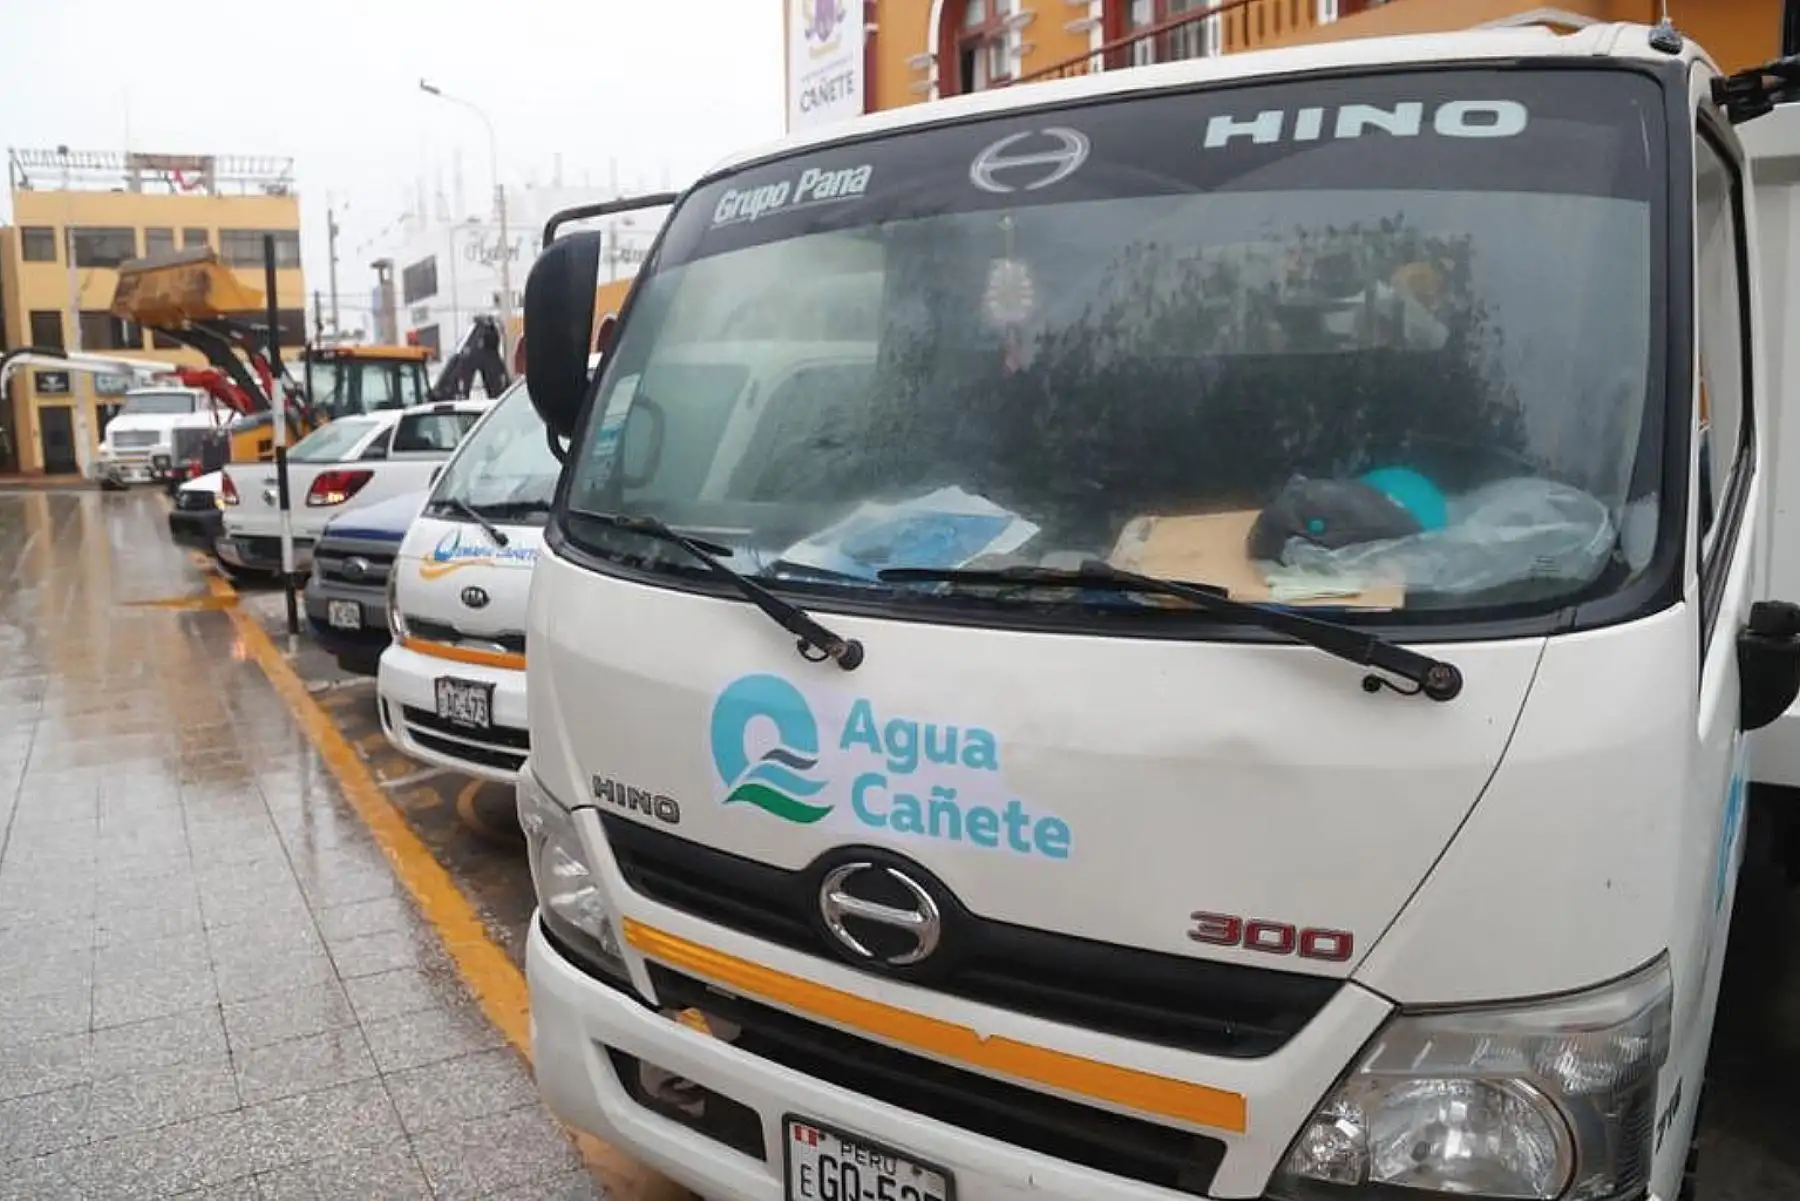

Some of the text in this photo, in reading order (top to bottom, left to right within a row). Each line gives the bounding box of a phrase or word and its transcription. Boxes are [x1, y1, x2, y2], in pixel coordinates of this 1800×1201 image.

[1203, 99, 1528, 148] HINO
[713, 164, 873, 222] Grupo Pana
[839, 698, 998, 774] Agua
[592, 775, 680, 824] HINO
[850, 772, 1072, 859] Cañete
[1187, 910, 1354, 962] 300
